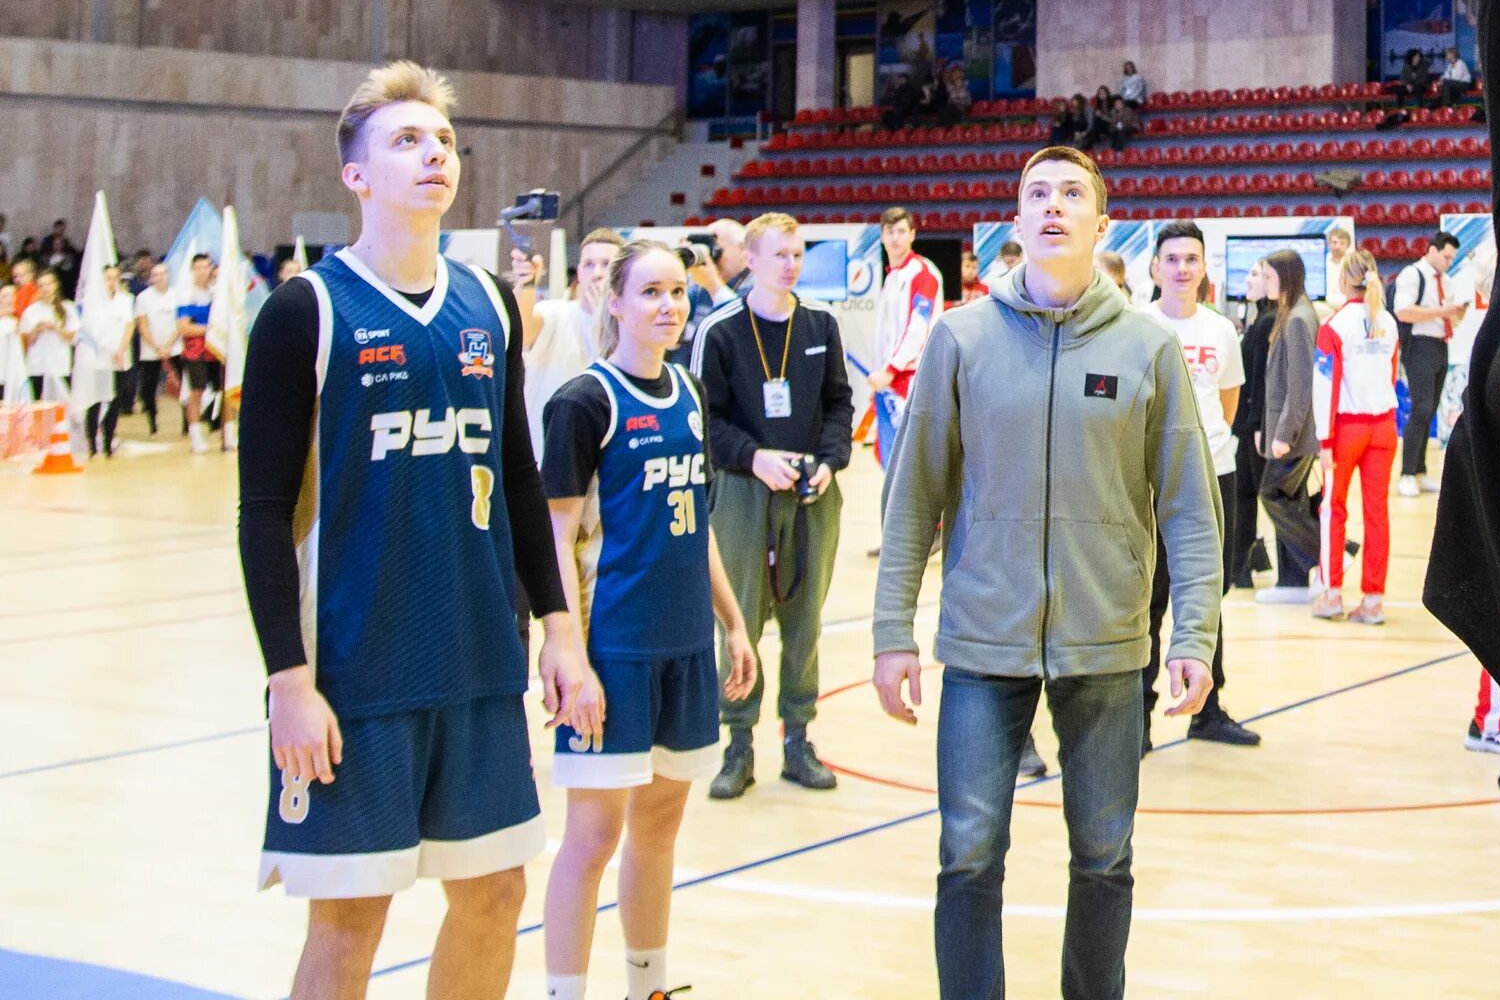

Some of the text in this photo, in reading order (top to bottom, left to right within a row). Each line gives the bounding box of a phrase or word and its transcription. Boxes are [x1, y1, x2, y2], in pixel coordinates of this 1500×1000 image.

[370, 407, 492, 462] РУС
[643, 453, 706, 491] РУС
[667, 489, 696, 536] 31
